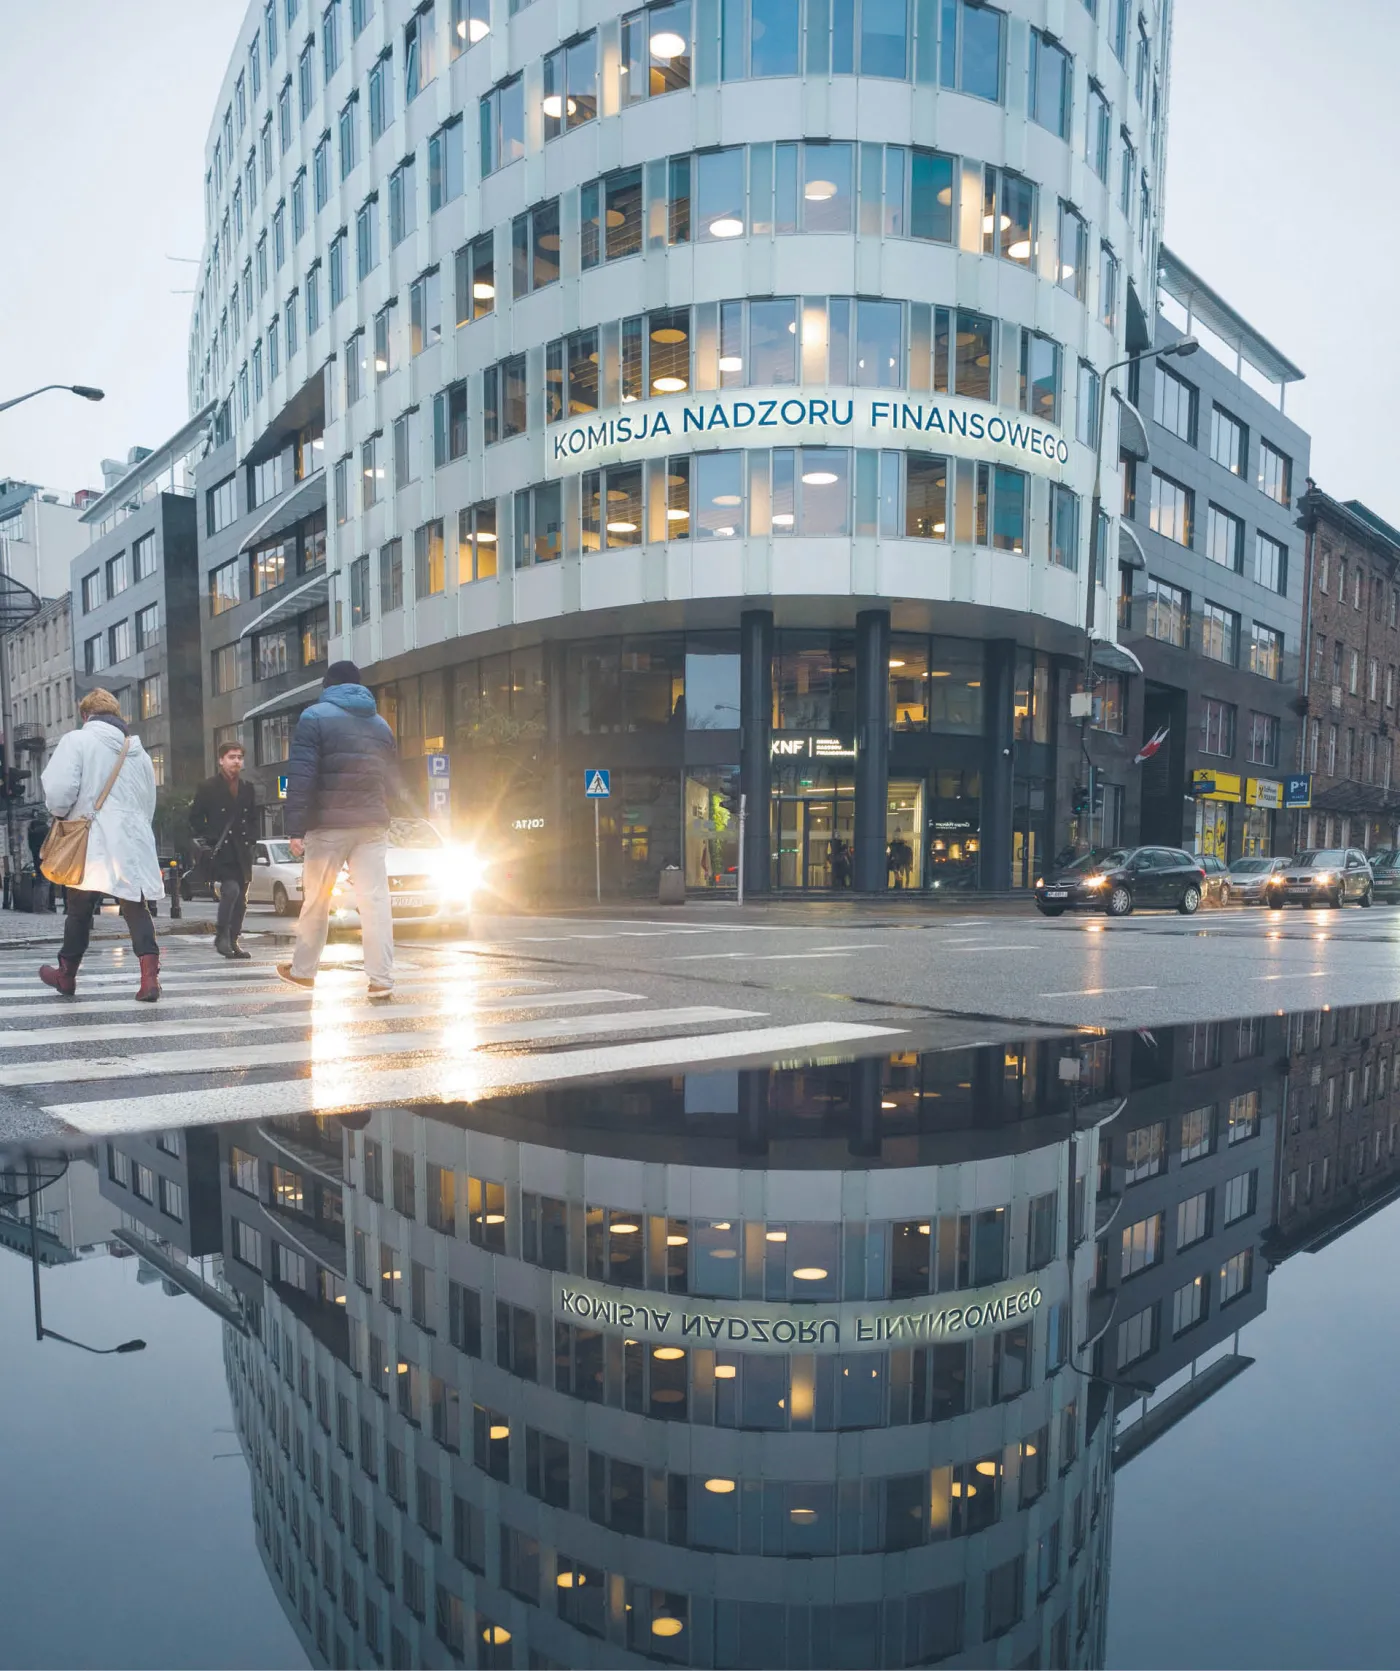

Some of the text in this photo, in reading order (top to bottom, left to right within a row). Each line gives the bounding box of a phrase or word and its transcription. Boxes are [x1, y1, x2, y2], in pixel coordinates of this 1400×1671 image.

[554, 399, 1069, 464] KOMISJA NADZORU FINANSOWEGO
[771, 740, 804, 754] KNF
[433, 757, 446, 775] P
[1291, 781, 1299, 793] P
